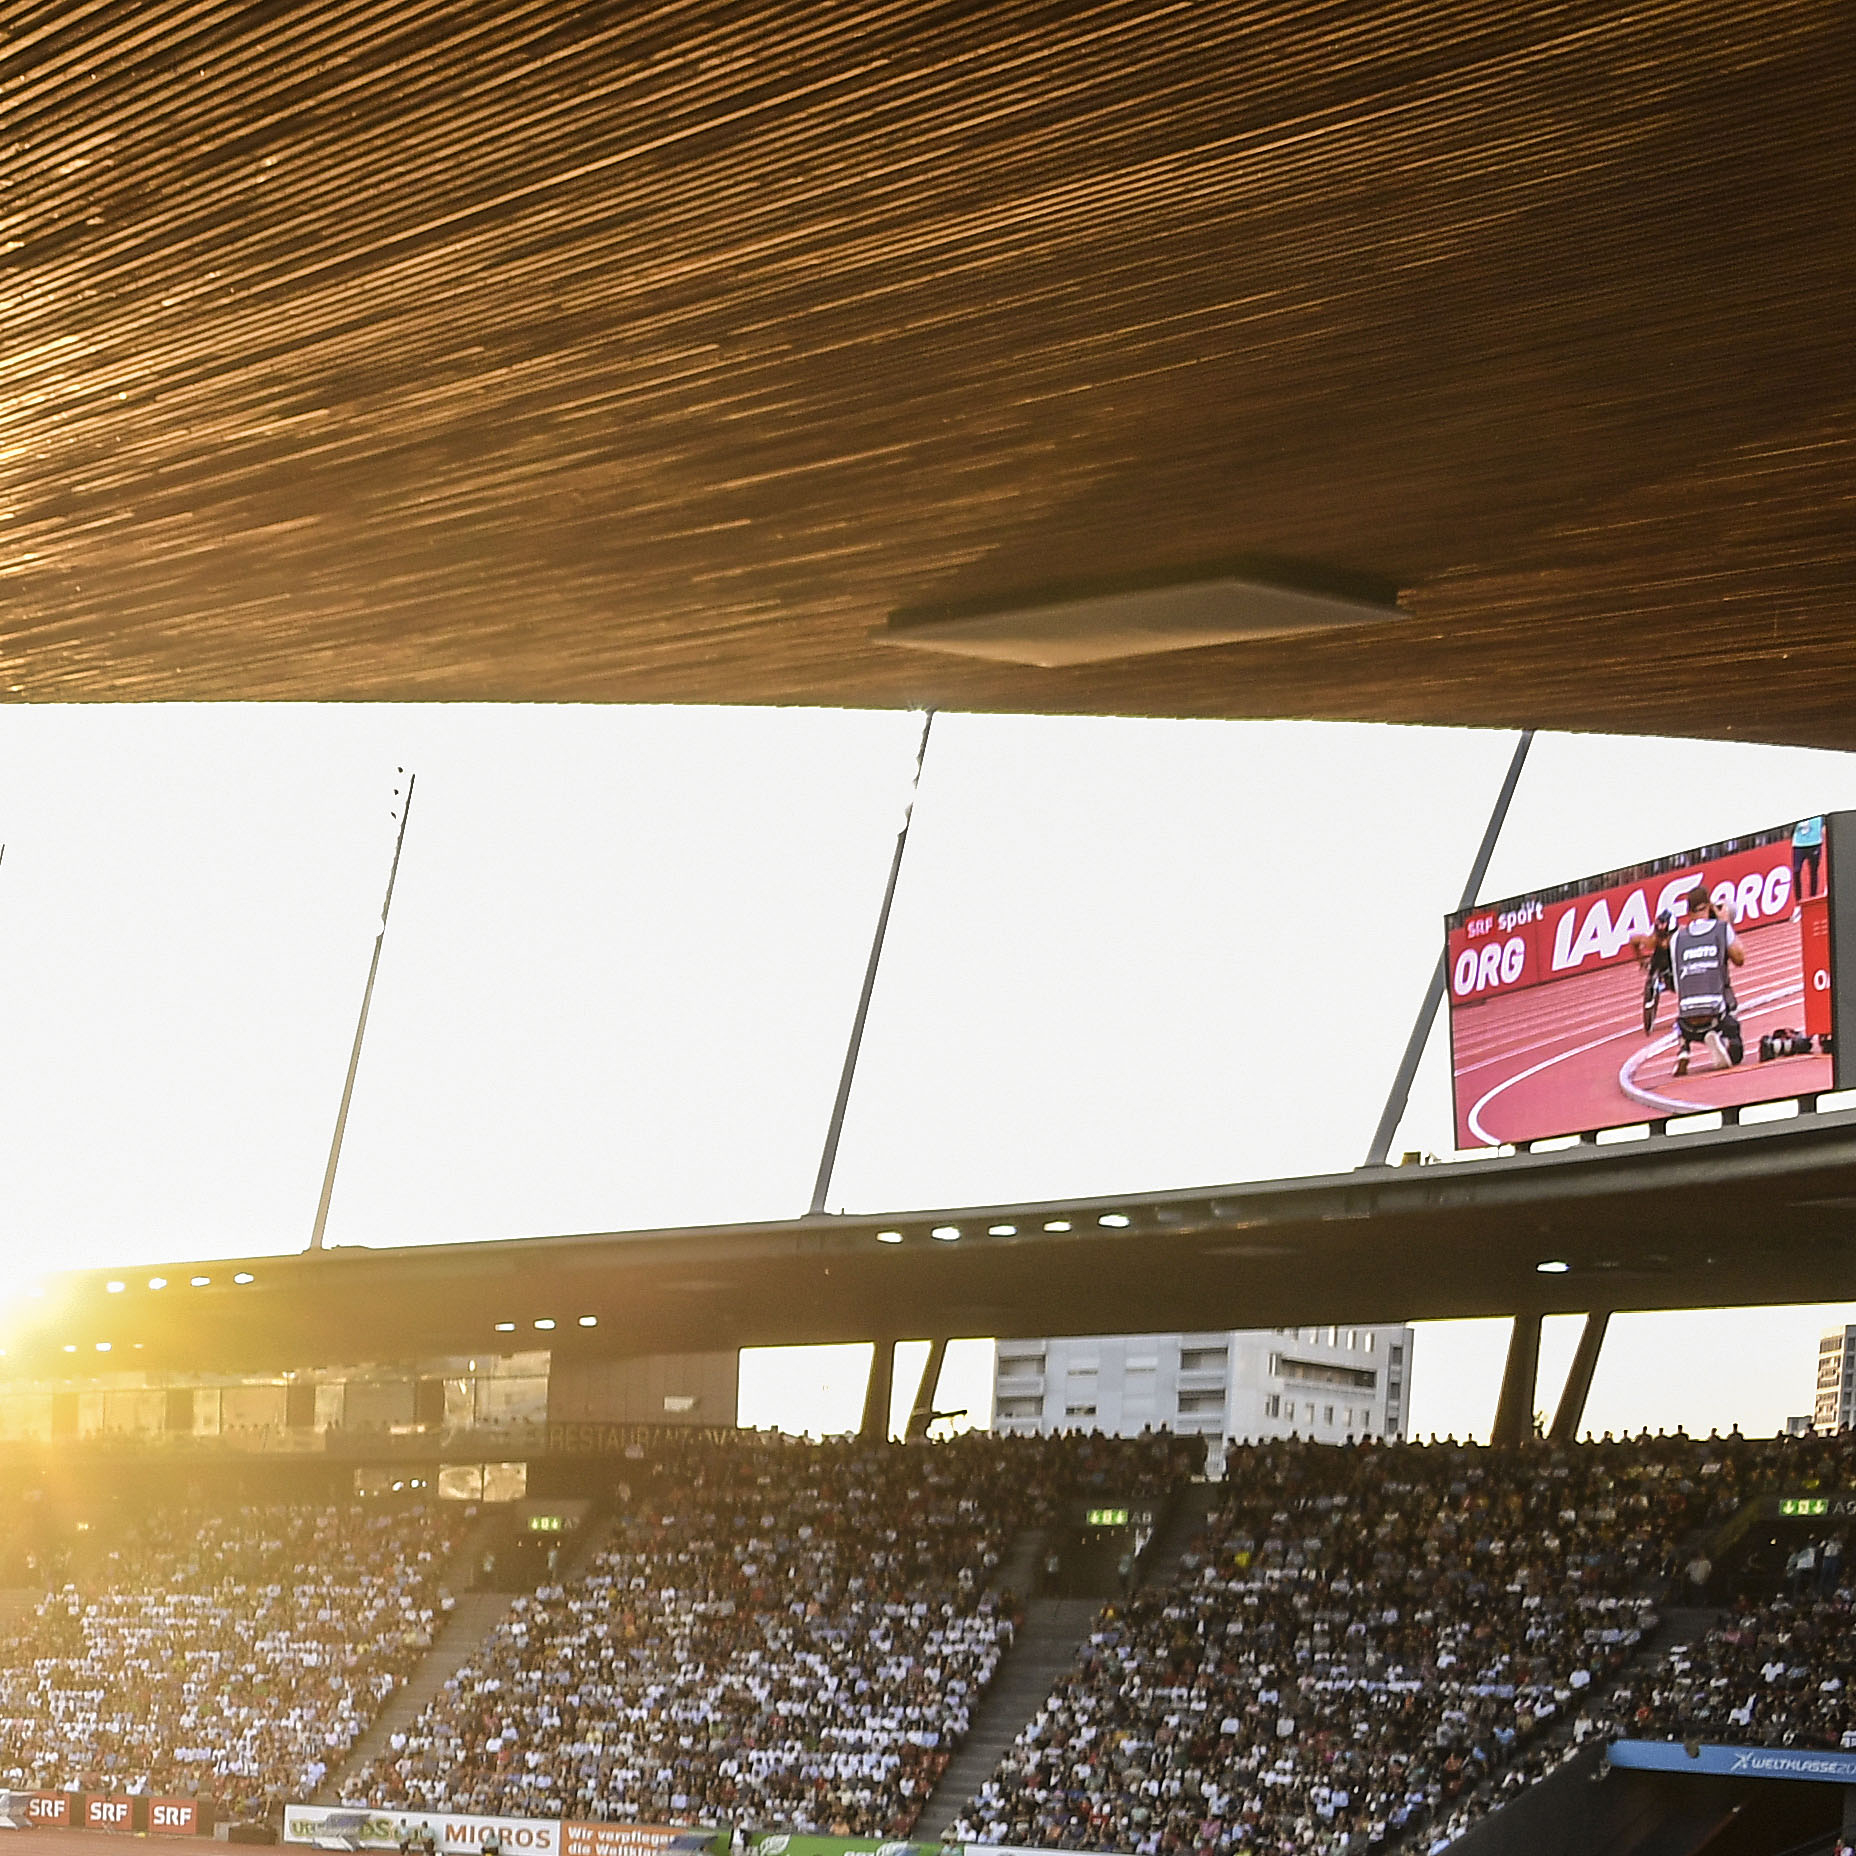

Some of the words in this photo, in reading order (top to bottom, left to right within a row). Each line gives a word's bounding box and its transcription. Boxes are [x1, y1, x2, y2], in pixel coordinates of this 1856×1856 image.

[1497, 900, 1544, 932] sport
[1454, 937, 1526, 996] ORG
[29, 1798, 65, 1818] SRF
[90, 1802, 128, 1822] SRF
[153, 1806, 192, 1827] SRF
[568, 1826, 594, 1840] Wir
